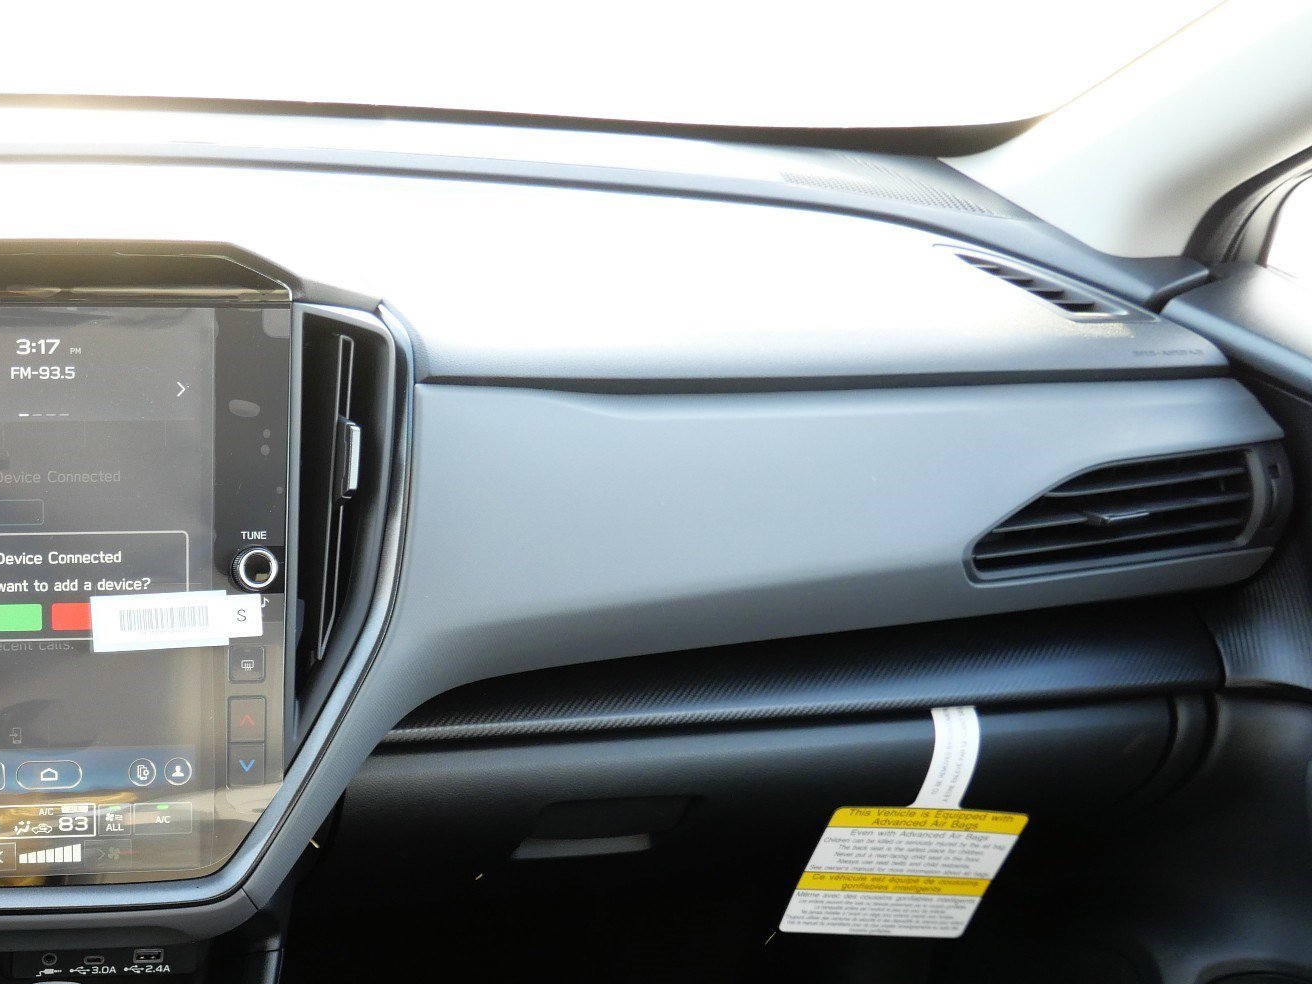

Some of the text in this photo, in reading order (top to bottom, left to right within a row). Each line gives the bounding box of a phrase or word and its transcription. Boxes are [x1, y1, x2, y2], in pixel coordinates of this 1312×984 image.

[16, 338, 82, 355] 3:17 PM
[10, 366, 76, 380] FM-93.5
[47, 470, 121, 483] Connected
[240, 531, 267, 540] TUNE
[48, 550, 122, 564] Connected
[34, 579, 49, 592] to
[54, 578, 79, 592] add
[84, 581, 92, 591] a
[97, 577, 151, 592] device?
[237, 609, 247, 622] S
[38, 808, 54, 816] A/C
[849, 808, 872, 817] This
[877, 809, 916, 818] Vehicle
[935, 810, 987, 821] Equipped
[991, 815, 1014, 823] with
[59, 817, 88, 832] 83
[155, 815, 171, 824] A/C
[871, 818, 927, 827] Advanced
[950, 820, 979, 830] Bags
[105, 822, 124, 832] ALL
[899, 830, 946, 839] Advanced
[91, 966, 117, 975] 3.0A
[145, 964, 171, 973] 2.4A
